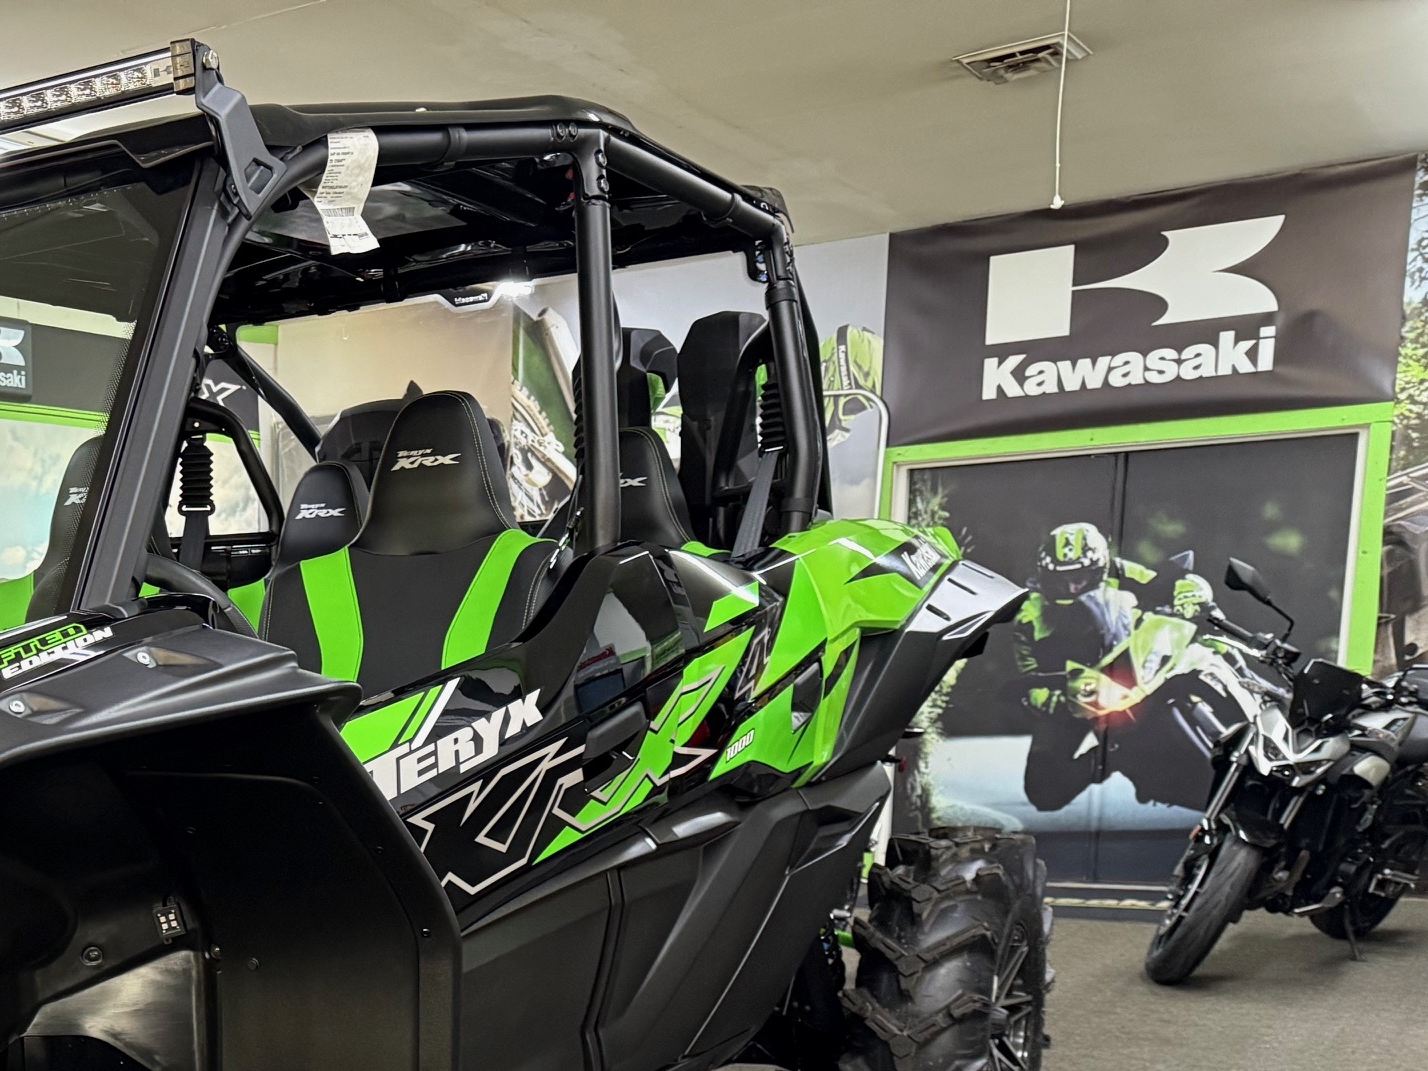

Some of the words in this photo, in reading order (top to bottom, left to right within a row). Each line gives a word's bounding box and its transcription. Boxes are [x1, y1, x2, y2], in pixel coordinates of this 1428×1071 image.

[981, 325, 1276, 401] Kawasaki
[390, 453, 462, 472] KRX
[294, 507, 346, 520] KRX
[1, 626, 114, 679] EDITION
[366, 688, 544, 802] TERYX
[725, 728, 756, 763] 1000
